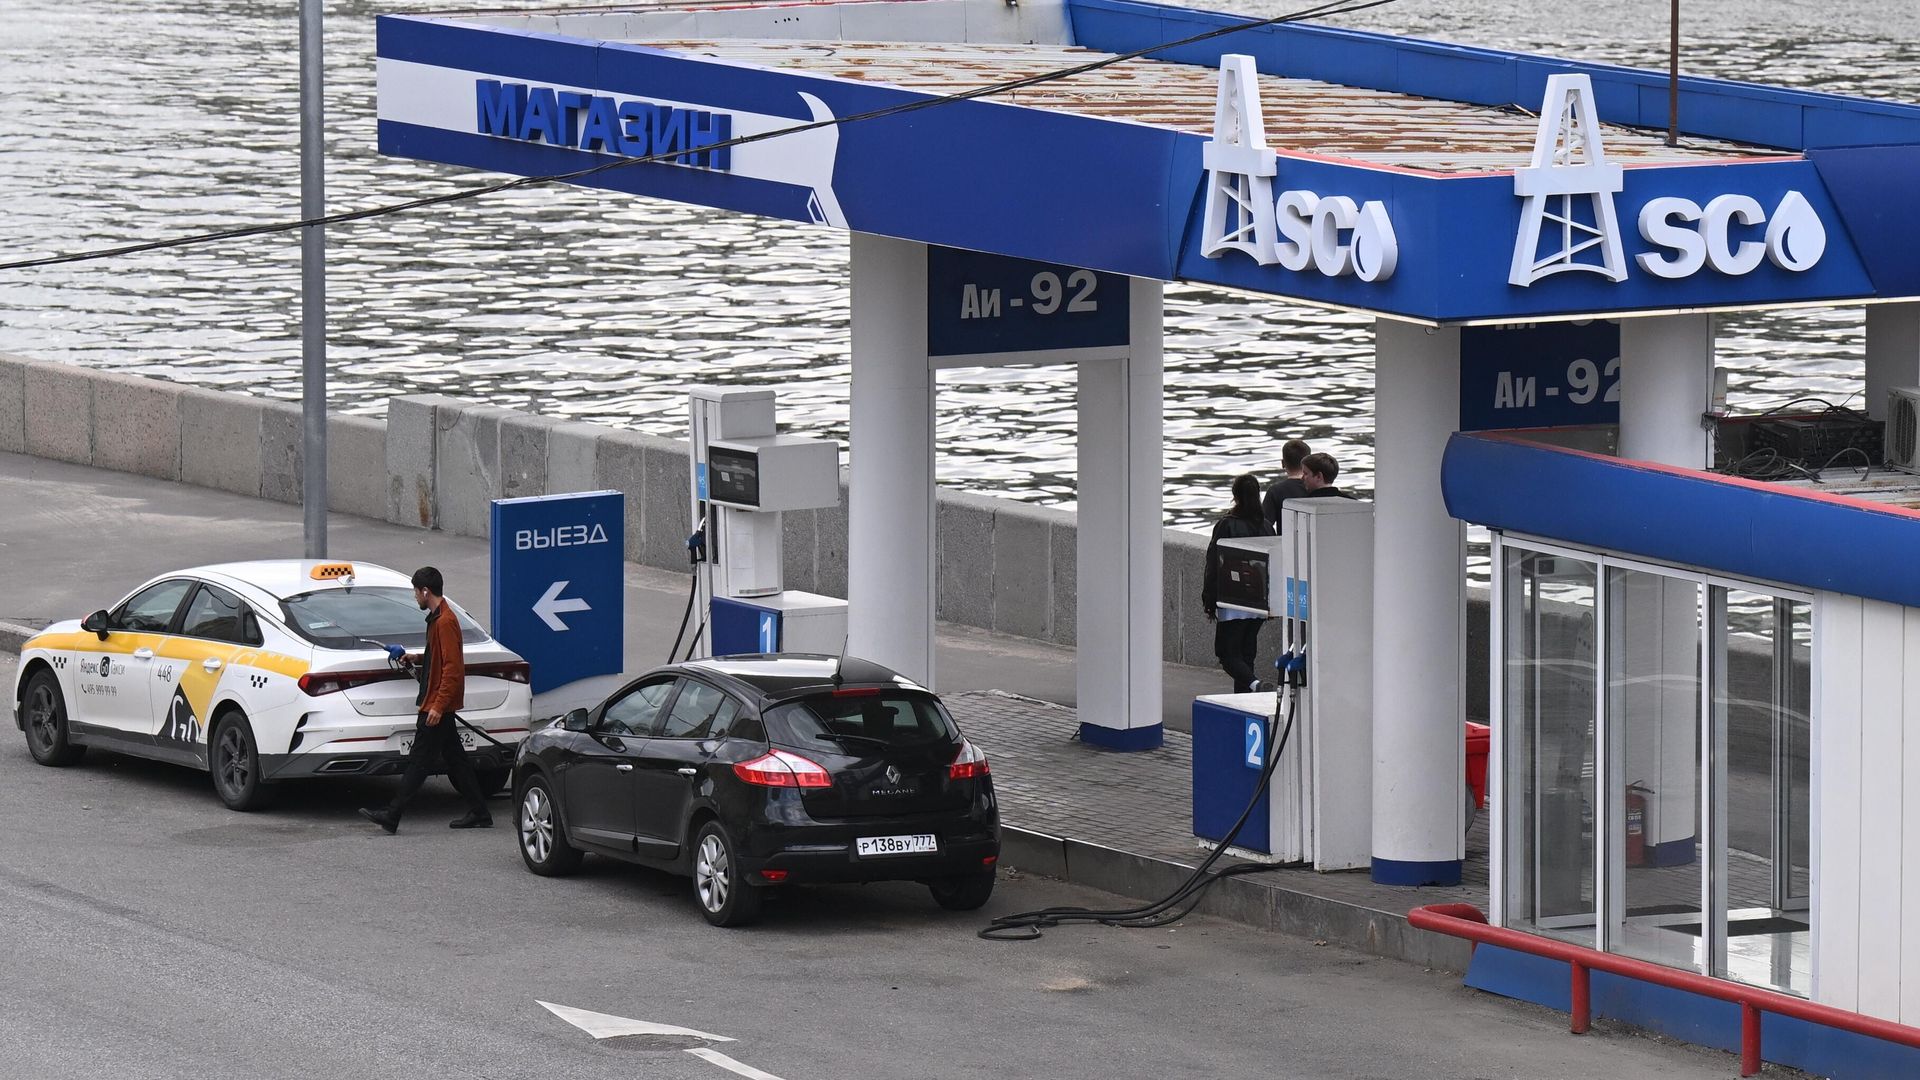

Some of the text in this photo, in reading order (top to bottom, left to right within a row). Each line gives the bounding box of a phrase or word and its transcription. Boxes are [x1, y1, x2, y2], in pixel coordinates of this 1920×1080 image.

[476, 78, 732, 171] МАГАЗИН
[515, 523, 609, 551] ВЫЕЗД
[762, 616, 771, 653] 1
[80, 656, 126, 677] Яндекс Go Такси
[157, 664, 172, 682] 448
[1247, 722, 1262, 766] 2
